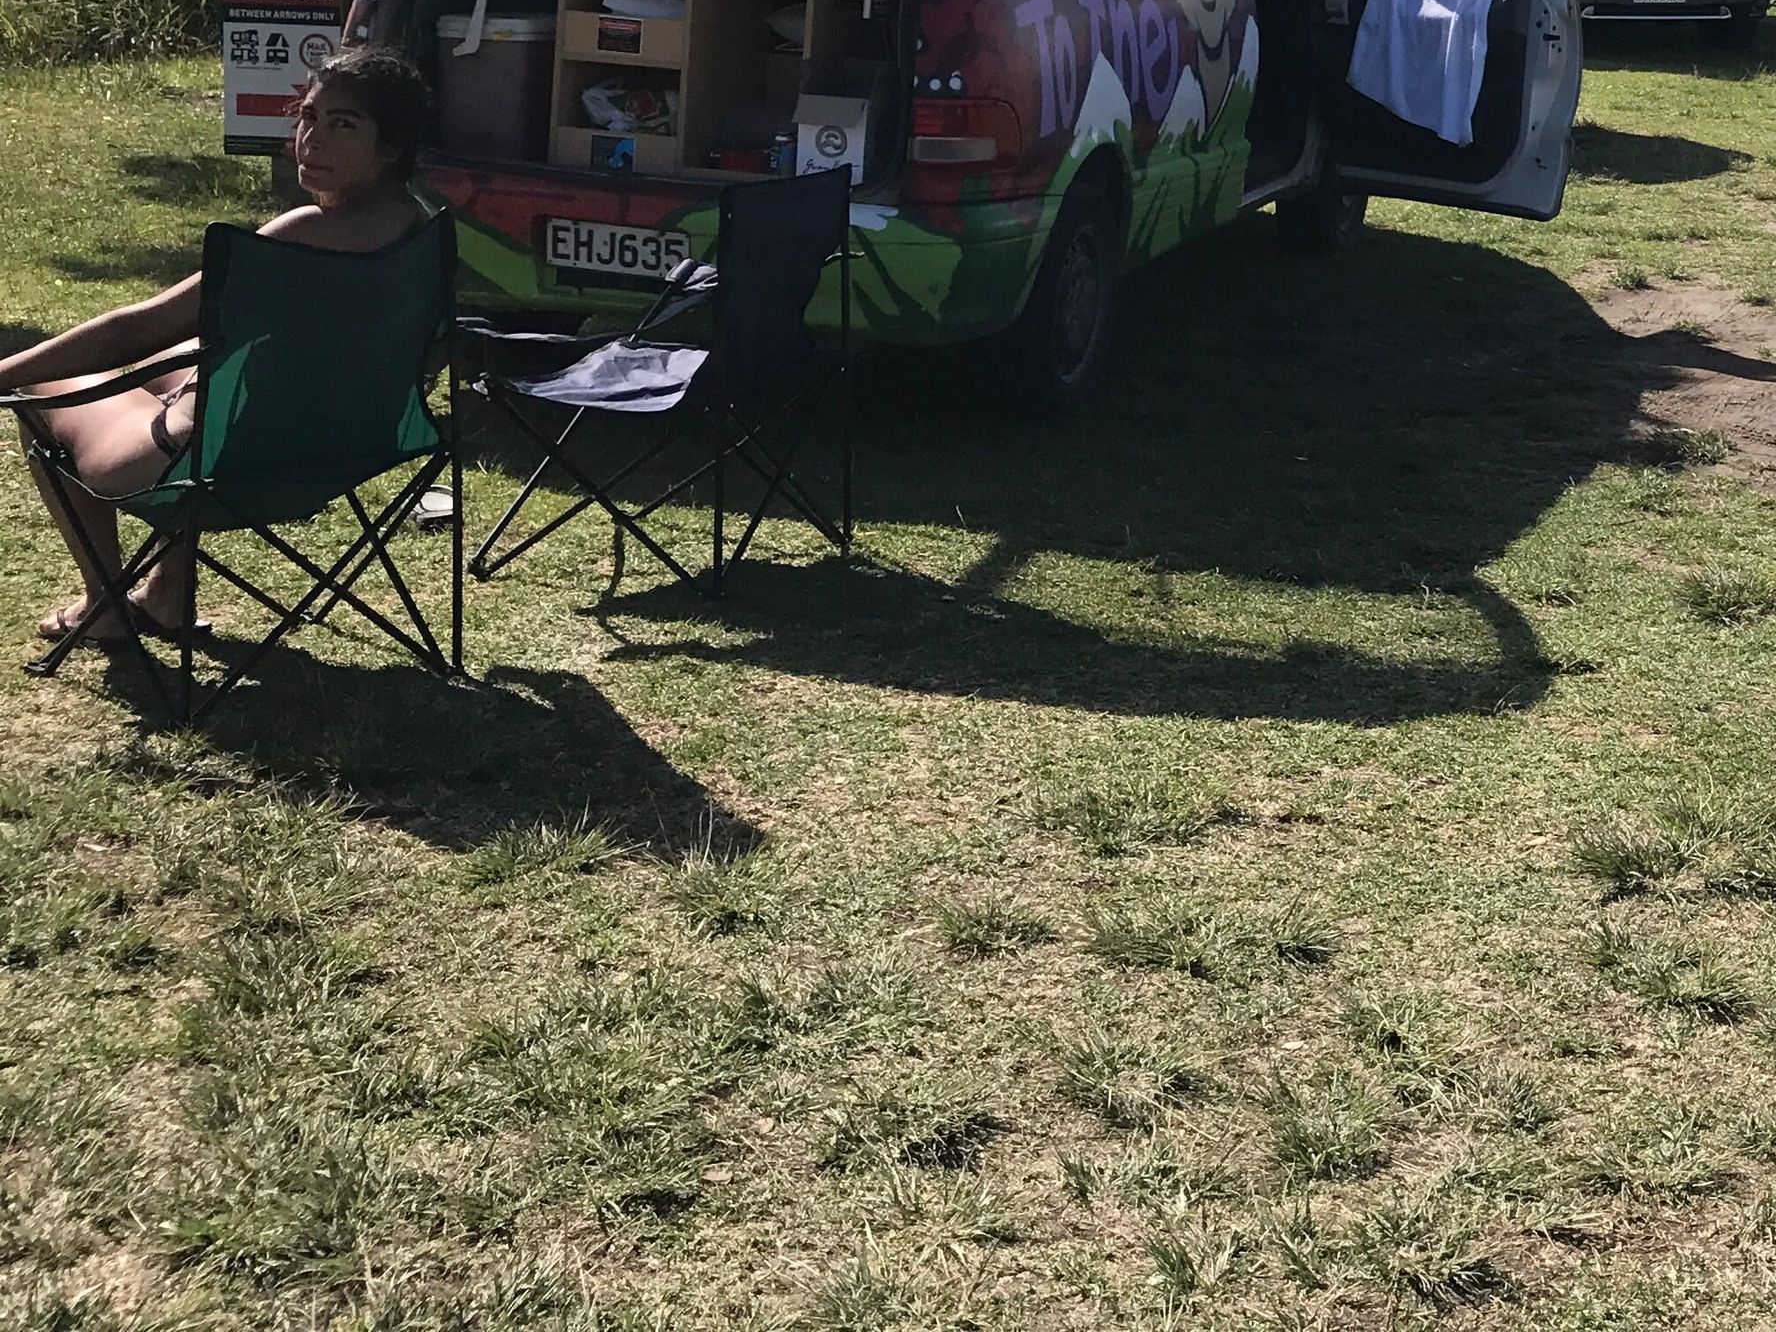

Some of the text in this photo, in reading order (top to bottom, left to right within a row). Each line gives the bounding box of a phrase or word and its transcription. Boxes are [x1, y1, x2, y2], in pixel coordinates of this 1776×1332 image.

[229, 8, 335, 21] BETWEEN ARROWS ONLY
[551, 225, 685, 272] EHJ635
